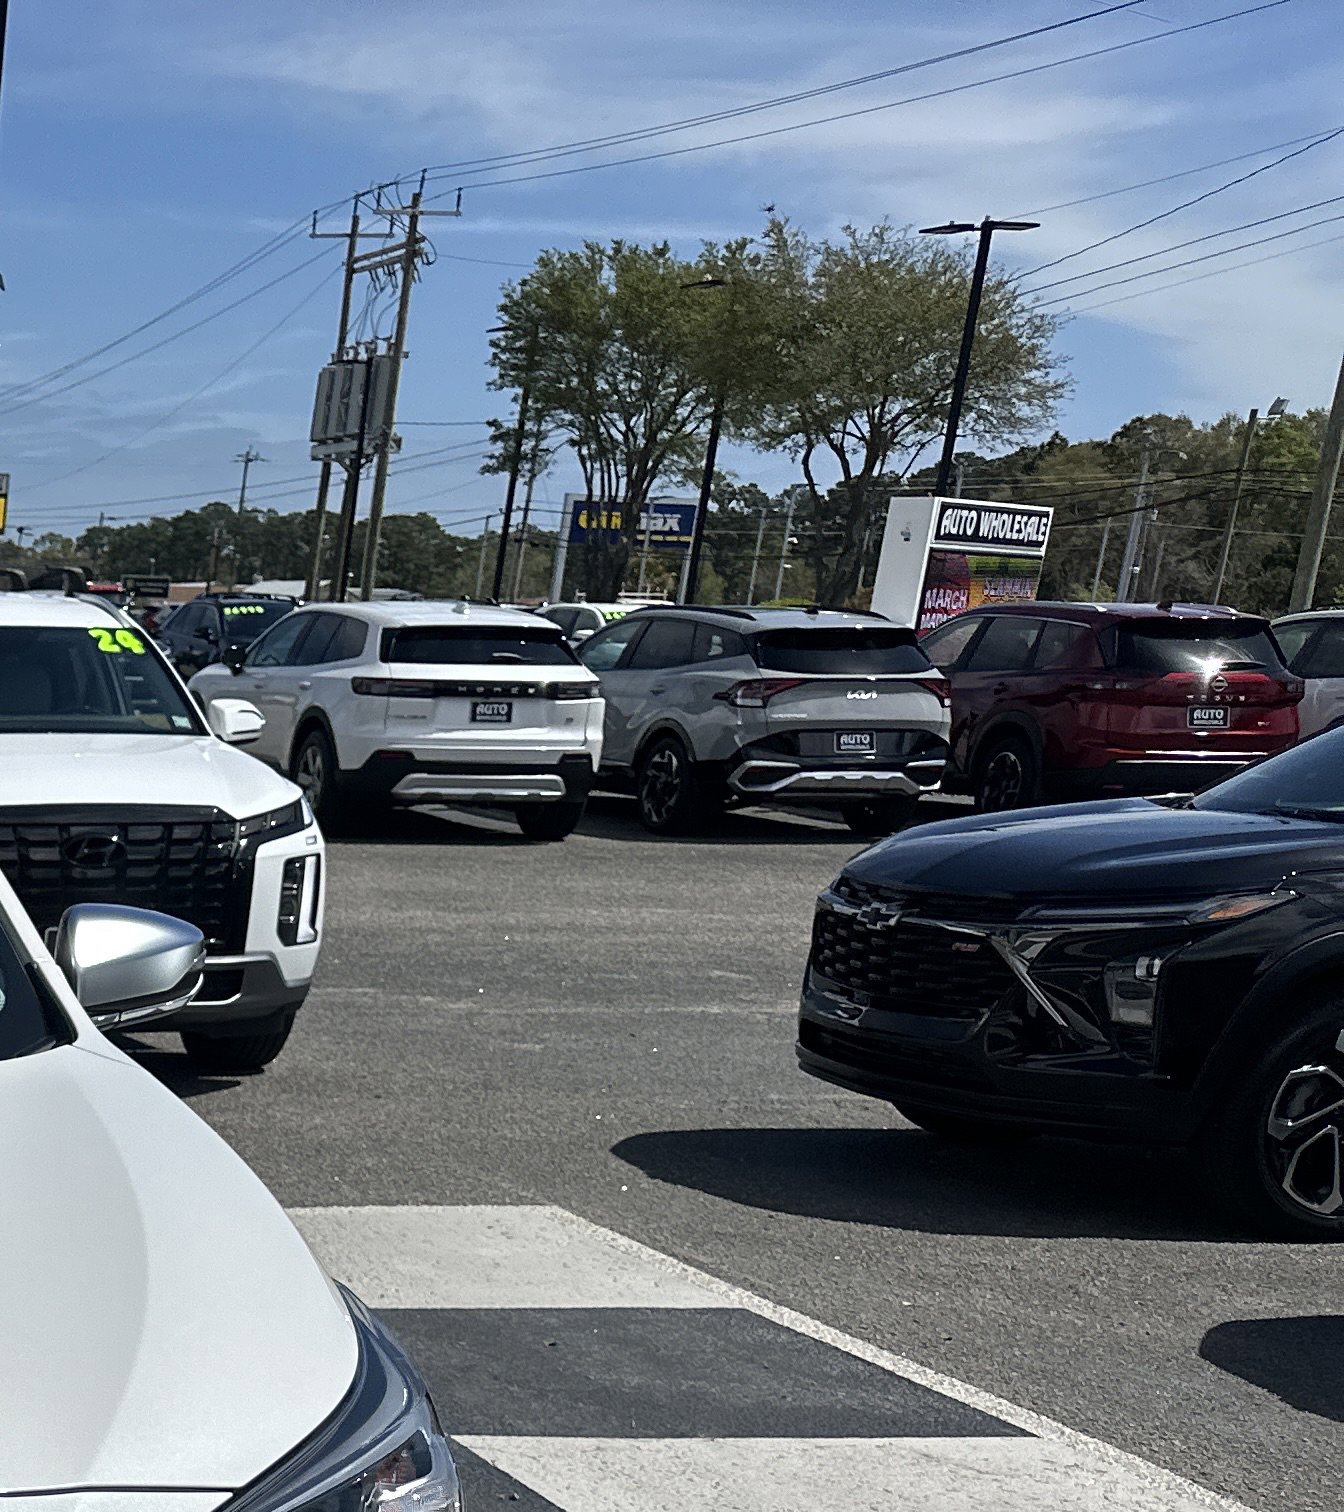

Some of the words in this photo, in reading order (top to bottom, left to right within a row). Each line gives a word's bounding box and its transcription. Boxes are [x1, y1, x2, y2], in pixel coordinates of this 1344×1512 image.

[939, 508, 978, 537] AUTO
[978, 511, 1048, 543] WHOLESALE
[923, 587, 969, 610] MARCH
[87, 628, 146, 655] 24
[475, 703, 509, 715] AUTO
[1193, 708, 1225, 720] AUTO
[839, 734, 870, 745] AUTO
